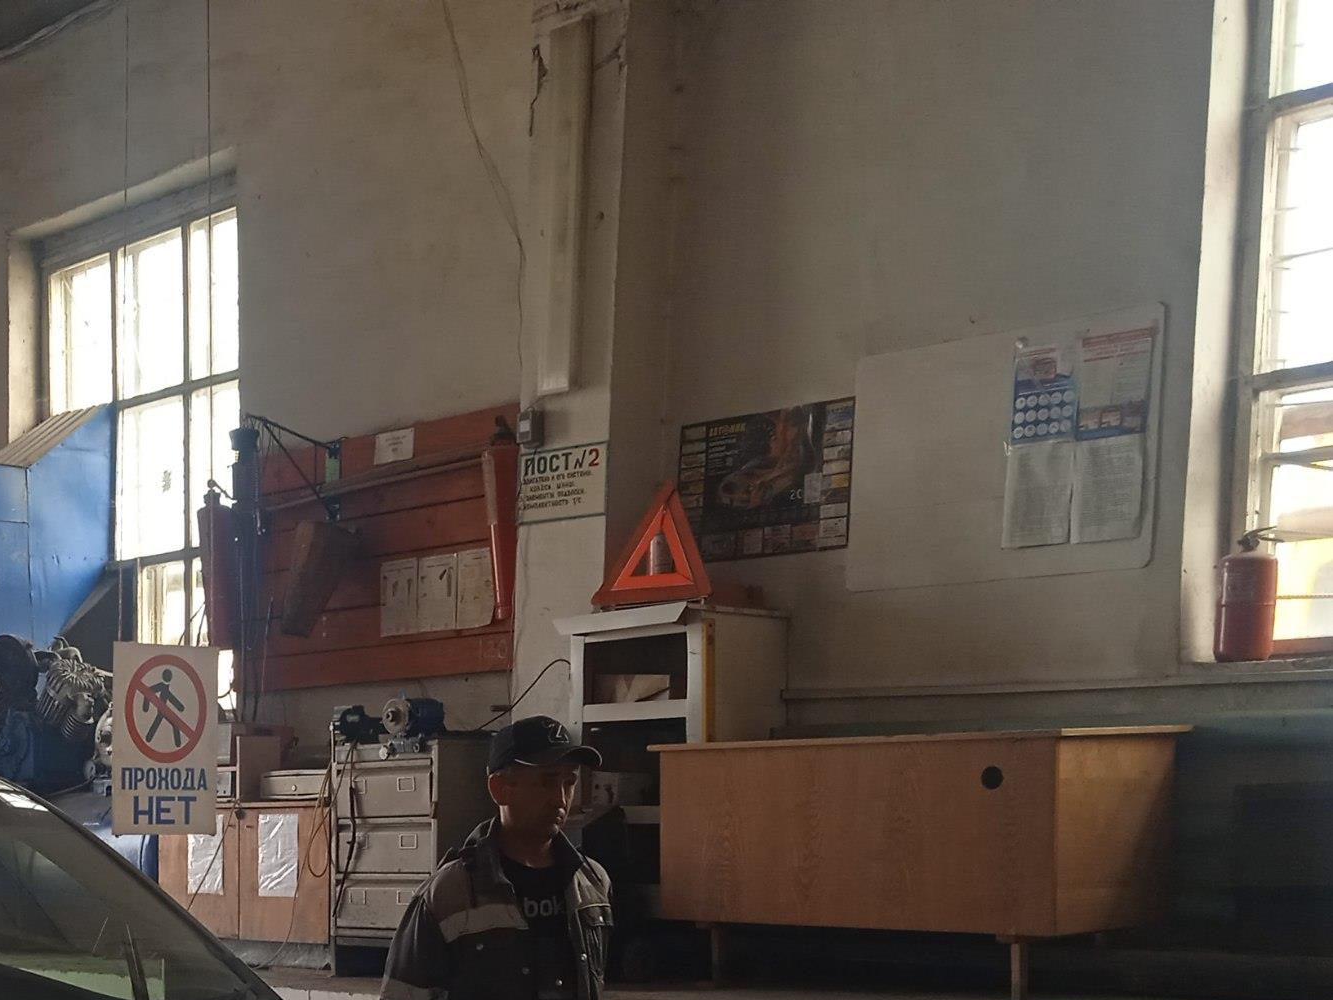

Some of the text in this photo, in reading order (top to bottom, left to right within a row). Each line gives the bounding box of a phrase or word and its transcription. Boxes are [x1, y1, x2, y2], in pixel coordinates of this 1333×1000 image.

[524, 452, 572, 476] ПОСТ
[121, 767, 208, 791] ПРОХОДА
[133, 796, 197, 825] НЕТ
